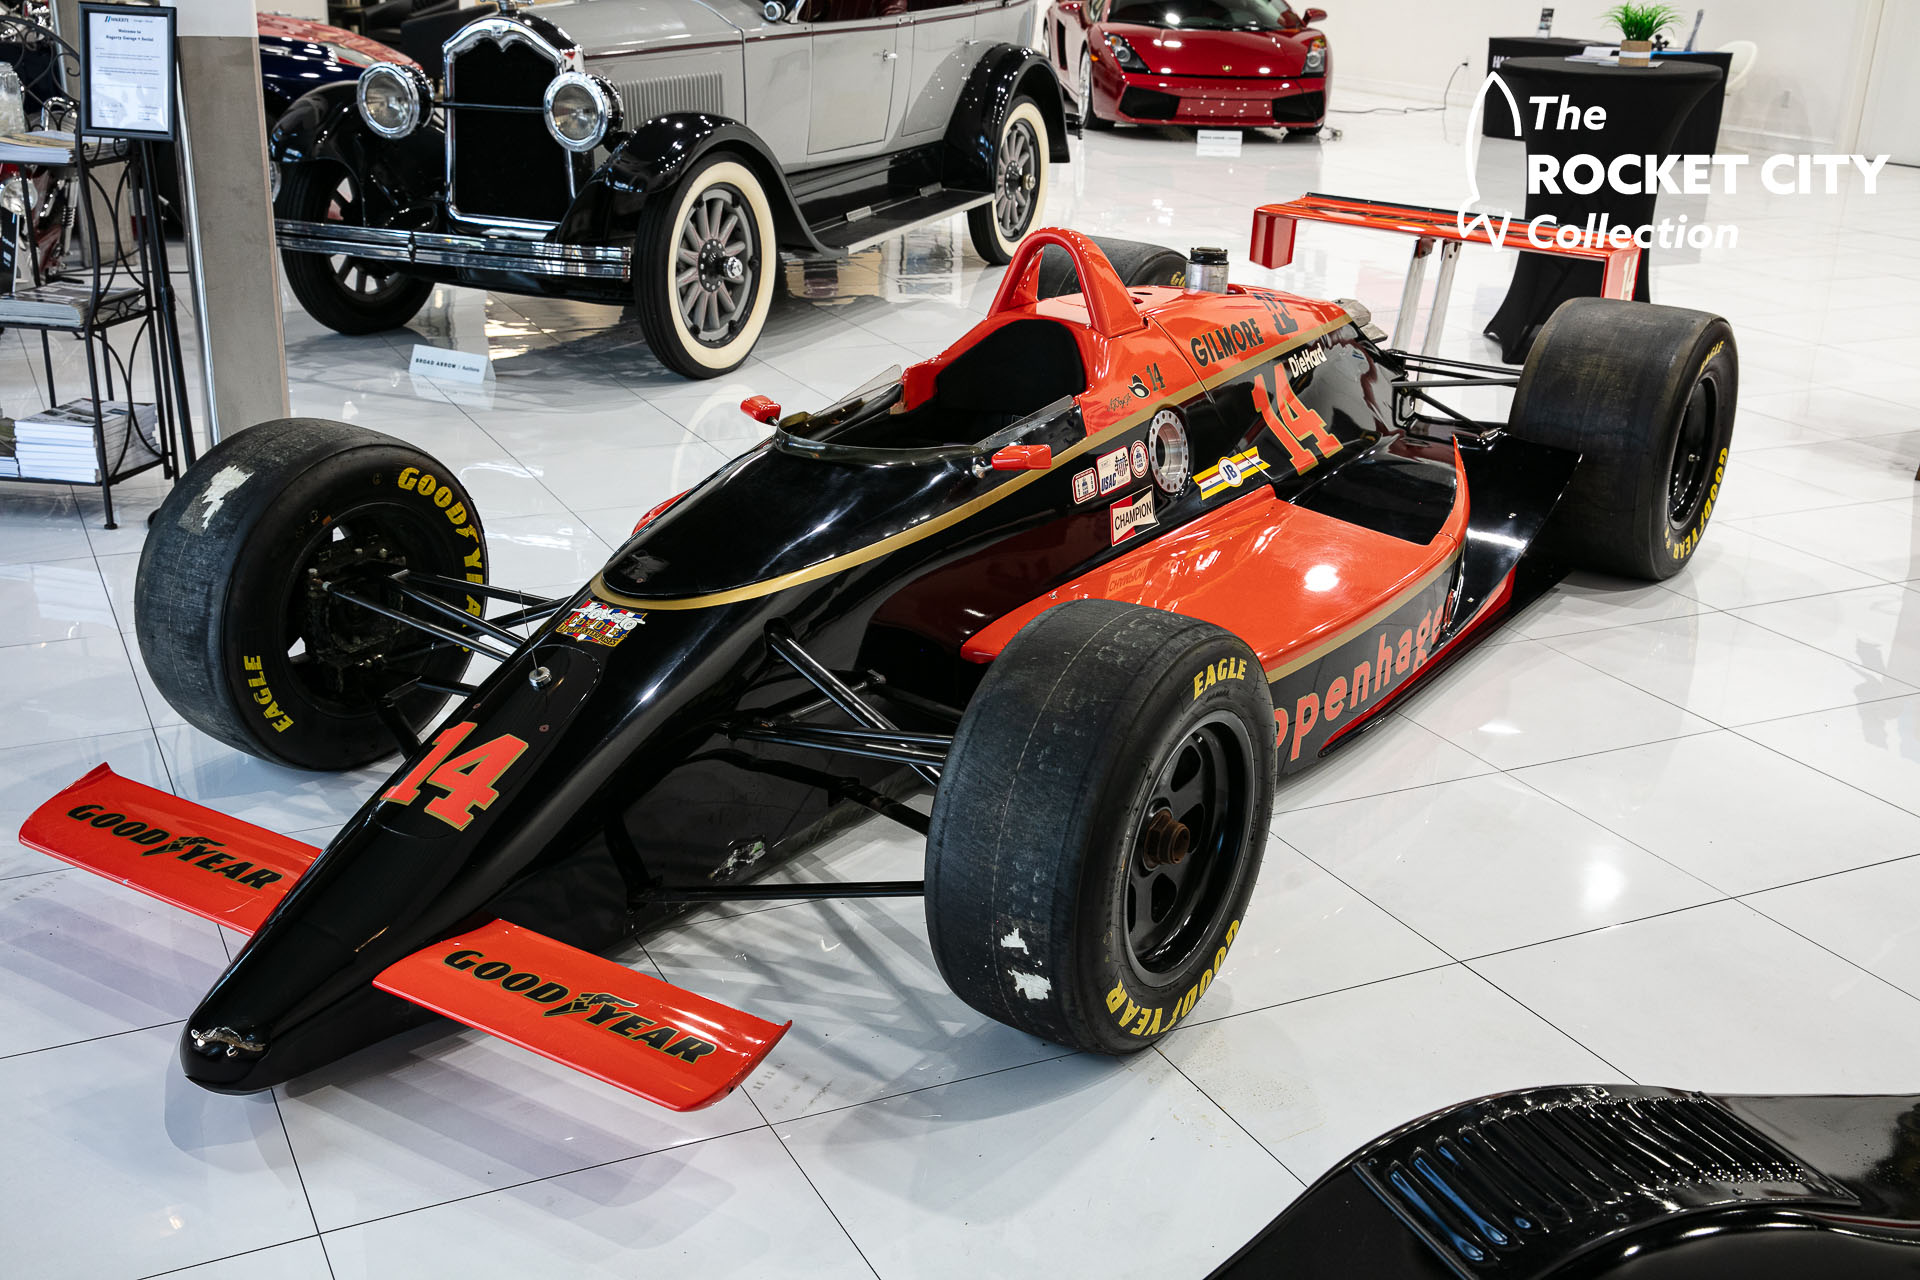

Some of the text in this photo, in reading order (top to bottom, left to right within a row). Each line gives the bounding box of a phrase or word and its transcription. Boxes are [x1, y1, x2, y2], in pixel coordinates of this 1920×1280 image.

[415, 358, 435, 366] BROAD
[436, 361, 457, 369] ARROW
[1191, 318, 1265, 367] GILMORE
[1289, 343, 1328, 378] DieHard
[1146, 362, 1166, 391] 14
[1251, 362, 1344, 475] 14
[1101, 473, 1117, 492] USAC
[1222, 464, 1238, 481] JB
[1114, 500, 1153, 530] CHAMPION
[397, 467, 484, 653] GOODYEA
[243, 655, 295, 732] EAGLE
[1193, 656, 1248, 701] EAGLE
[380, 721, 530, 832] 14
[66, 804, 284, 890] GOODYEAR
[443, 950, 718, 1065] GOODYEAR
